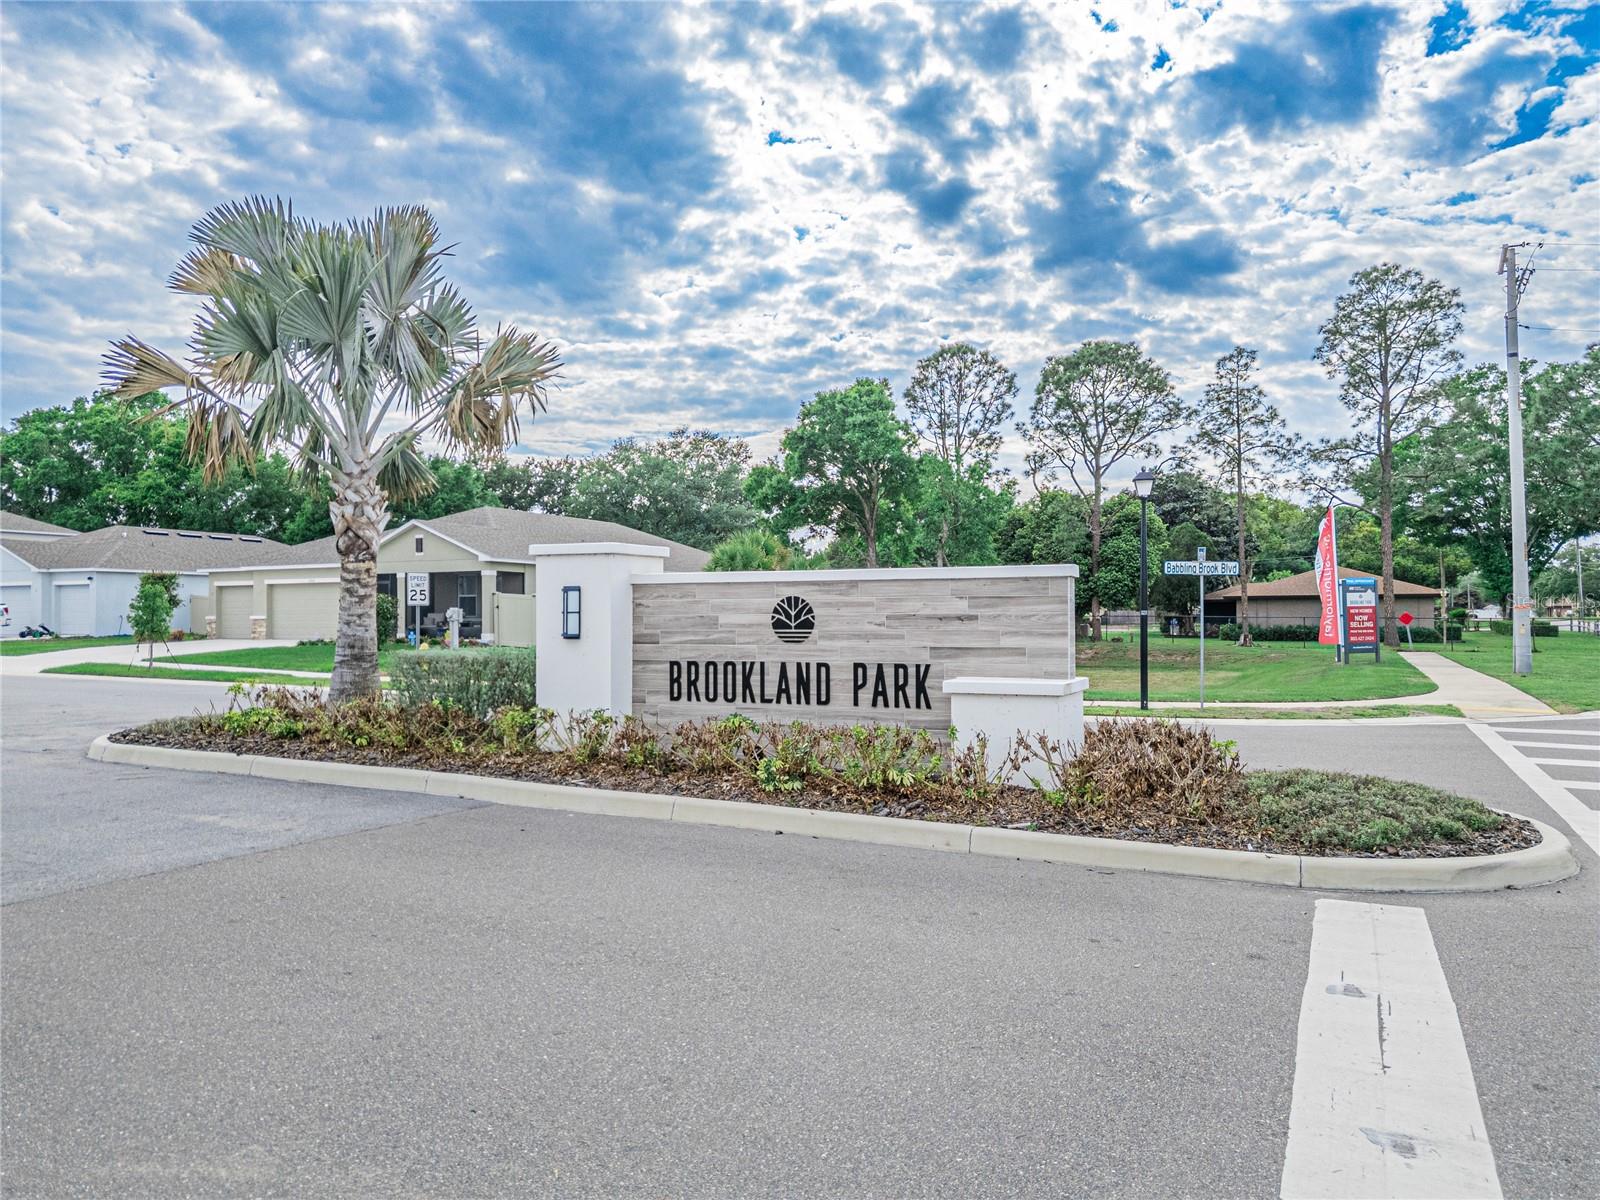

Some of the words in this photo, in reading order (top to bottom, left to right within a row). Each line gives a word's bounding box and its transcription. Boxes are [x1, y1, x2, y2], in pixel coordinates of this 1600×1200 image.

[1166, 563, 1196, 573] Babbling
[1198, 563, 1218, 573] Brook
[1221, 563, 1237, 574] Blvd
[410, 589, 427, 601] 25
[669, 660, 831, 706] BROOKLAND
[852, 662, 932, 710] PARK
